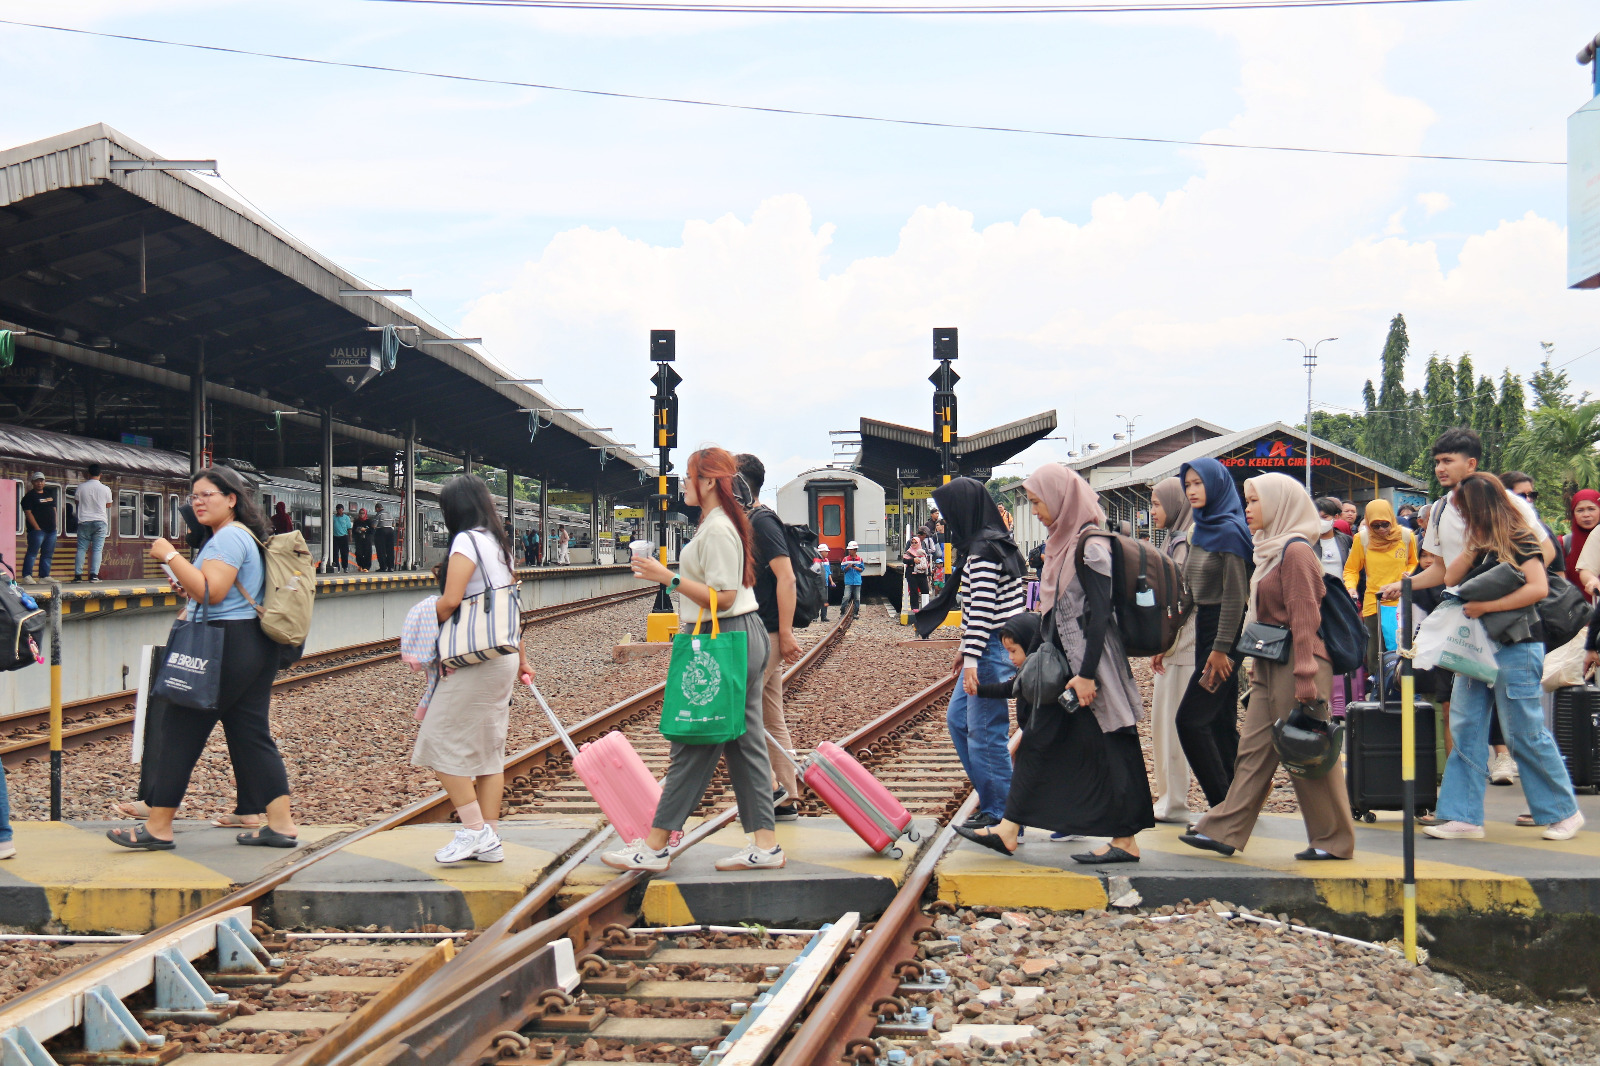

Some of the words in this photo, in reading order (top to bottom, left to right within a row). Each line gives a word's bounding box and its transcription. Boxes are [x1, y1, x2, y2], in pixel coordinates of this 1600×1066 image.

[330, 347, 368, 357] JALUR
[346, 375, 356, 385] 4
[1255, 441, 1293, 457] KAI
[1249, 458, 1285, 467] KERETA
[177, 653, 209, 670] BRADY
